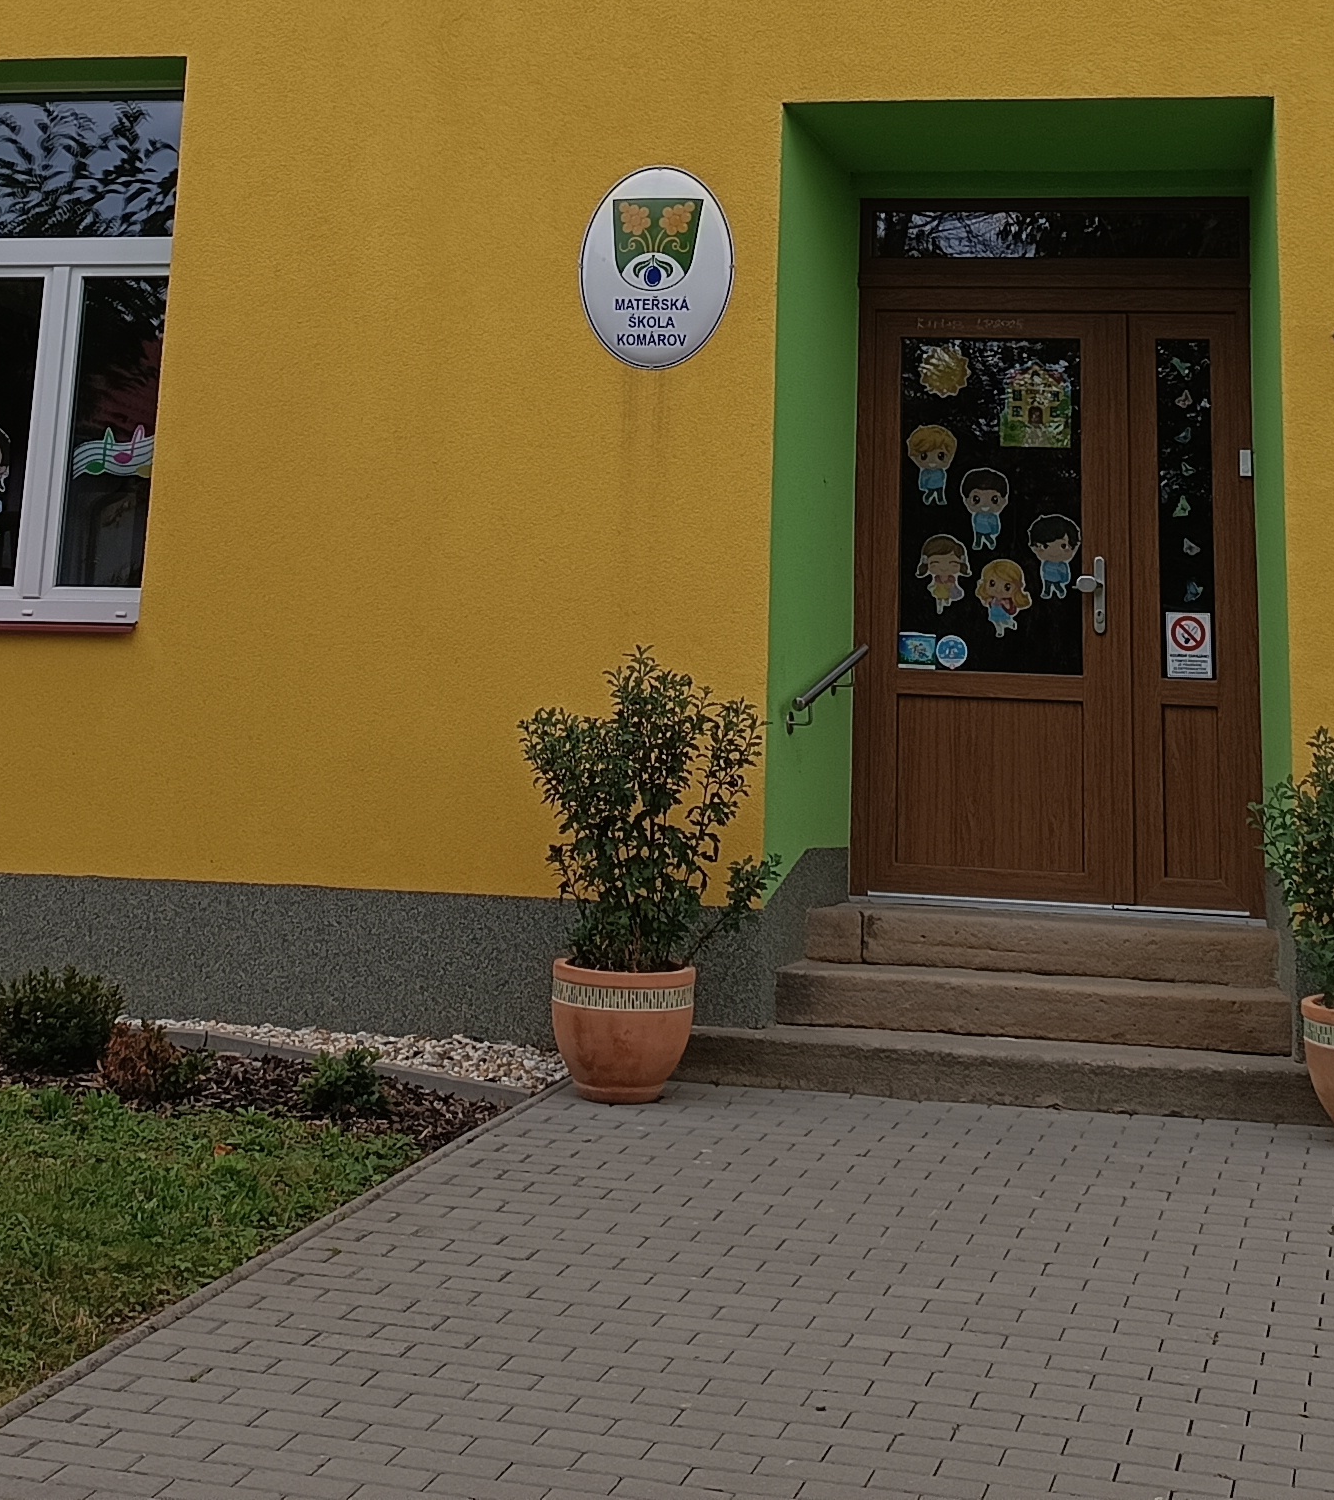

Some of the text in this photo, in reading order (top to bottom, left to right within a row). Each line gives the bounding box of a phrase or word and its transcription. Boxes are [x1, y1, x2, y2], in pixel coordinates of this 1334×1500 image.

[615, 295, 690, 311] MATEŘSKÁ
[628, 313, 676, 328] ŠKOLA
[617, 331, 687, 347] KOMÁROV
